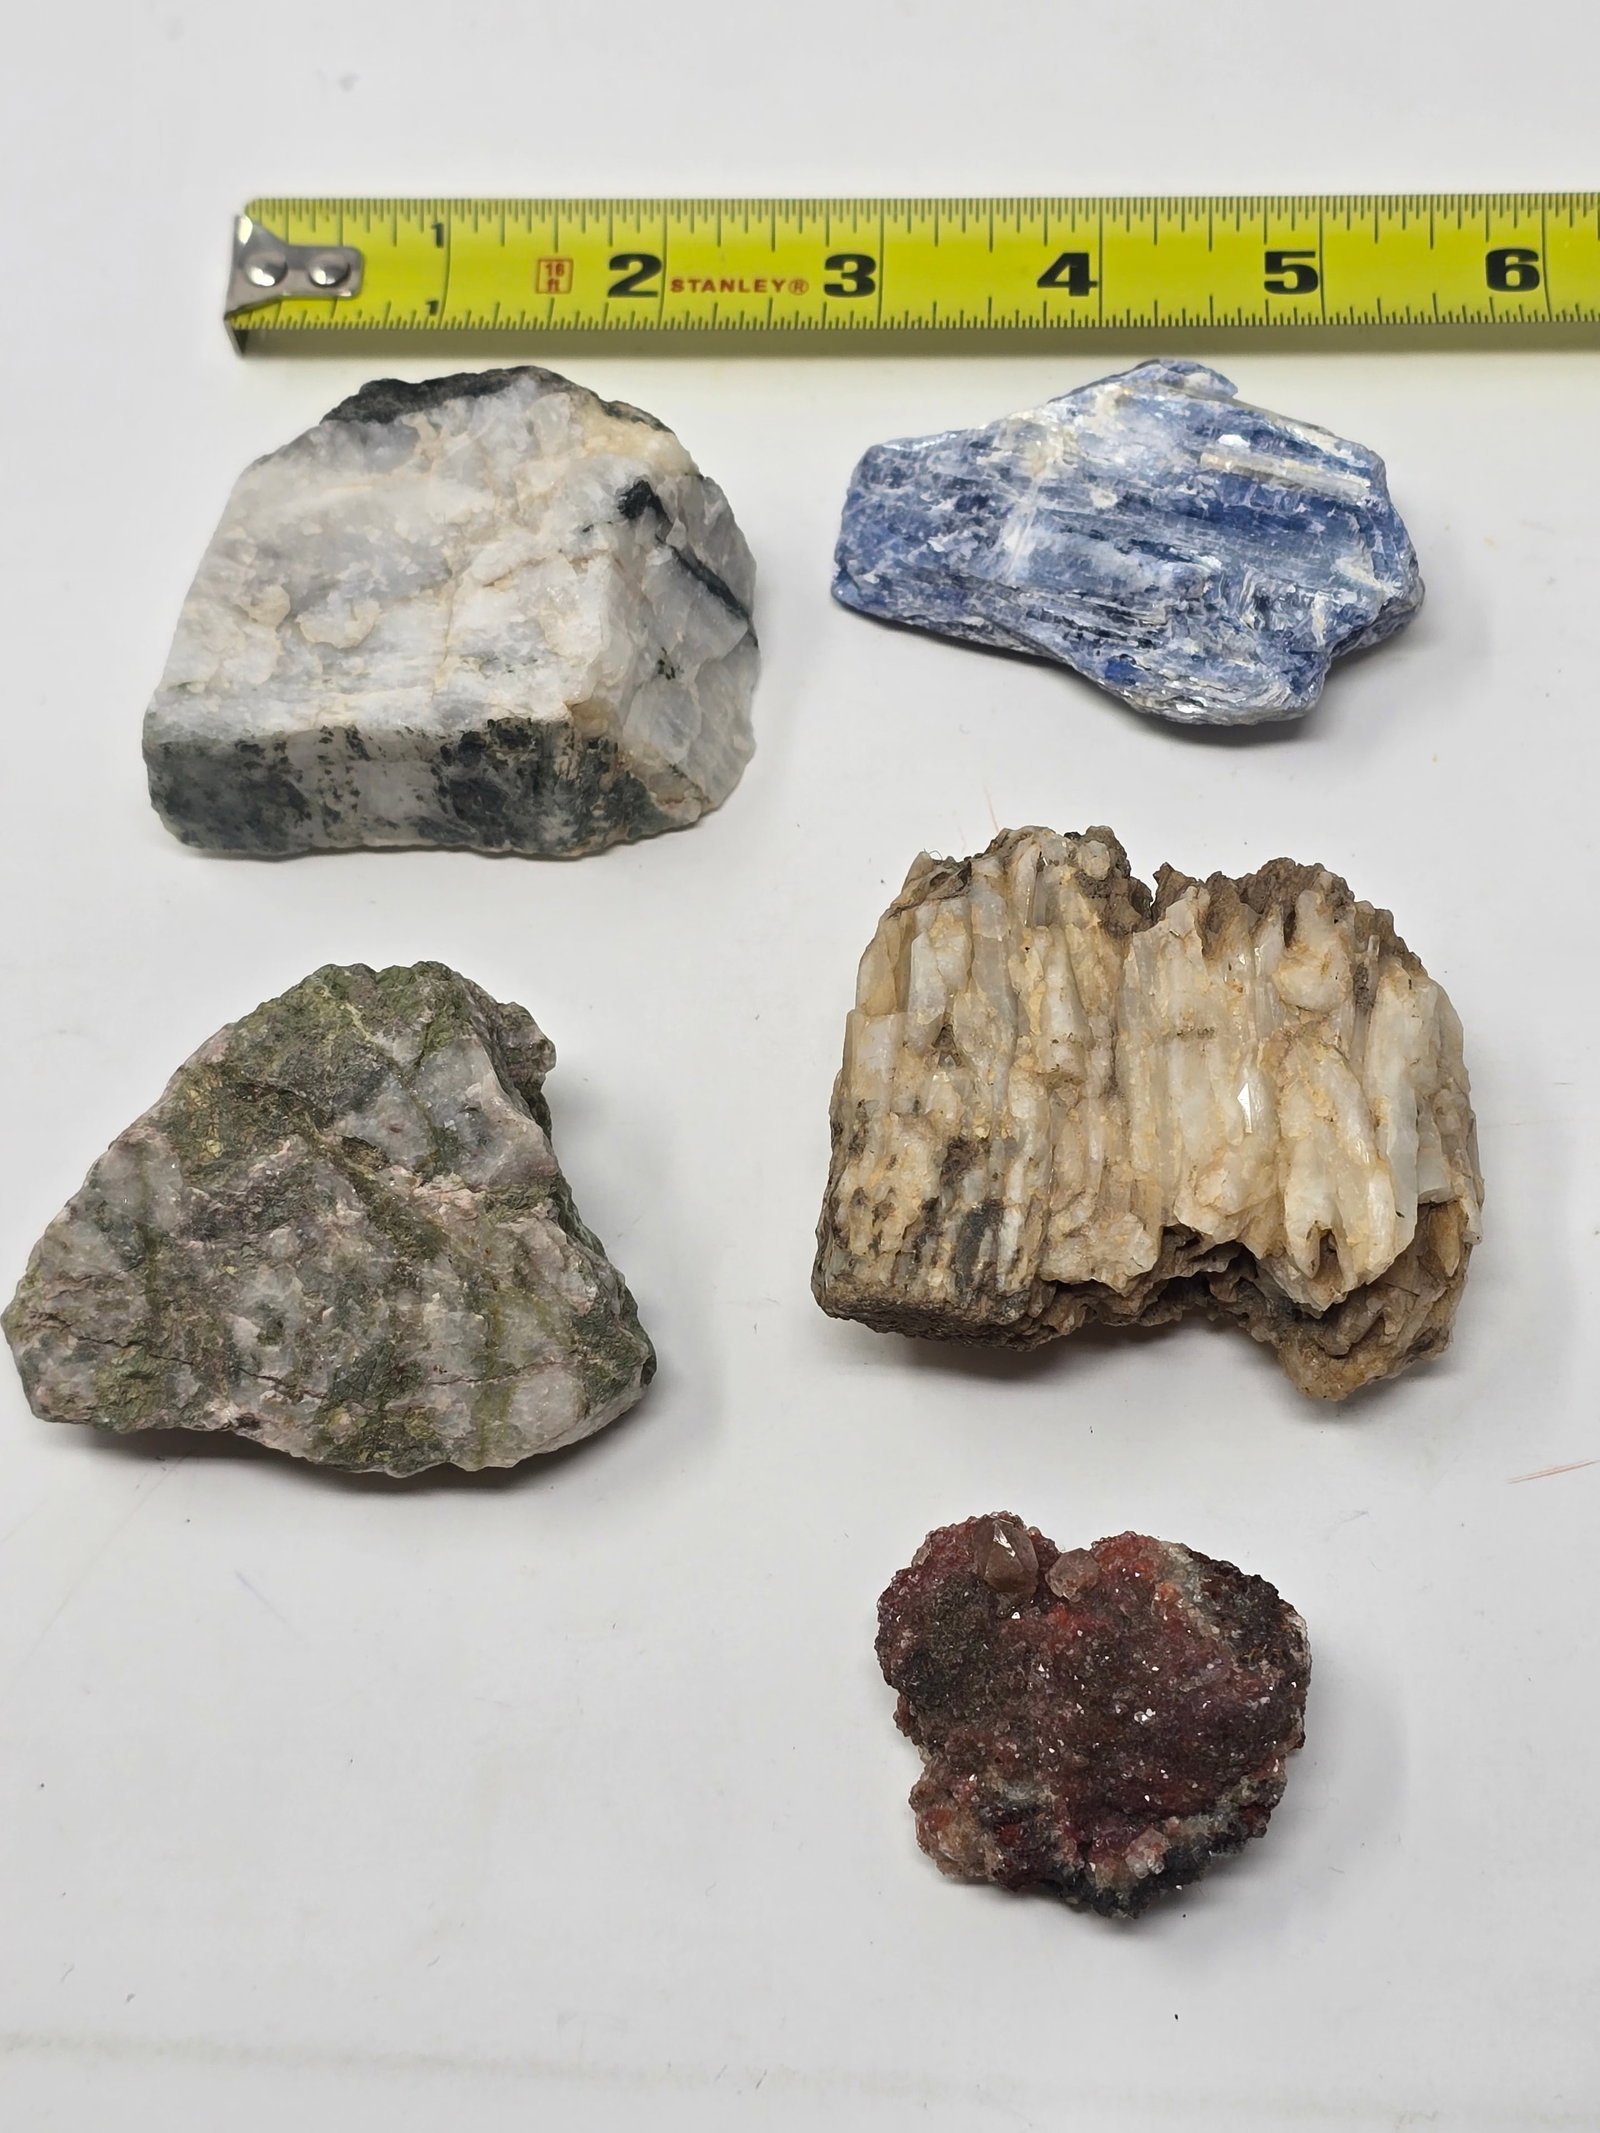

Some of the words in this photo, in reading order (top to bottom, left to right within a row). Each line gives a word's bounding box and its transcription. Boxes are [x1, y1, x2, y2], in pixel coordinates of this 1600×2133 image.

[430, 222, 445, 249] 1
[544, 262, 565, 278] 16
[547, 279, 561, 291] ft
[607, 253, 663, 298] 2
[823, 253, 877, 298] 3
[1036, 252, 1098, 297] 4
[1263, 250, 1319, 295] 5
[1485, 248, 1541, 293] 6
[425, 300, 439, 316] 1
